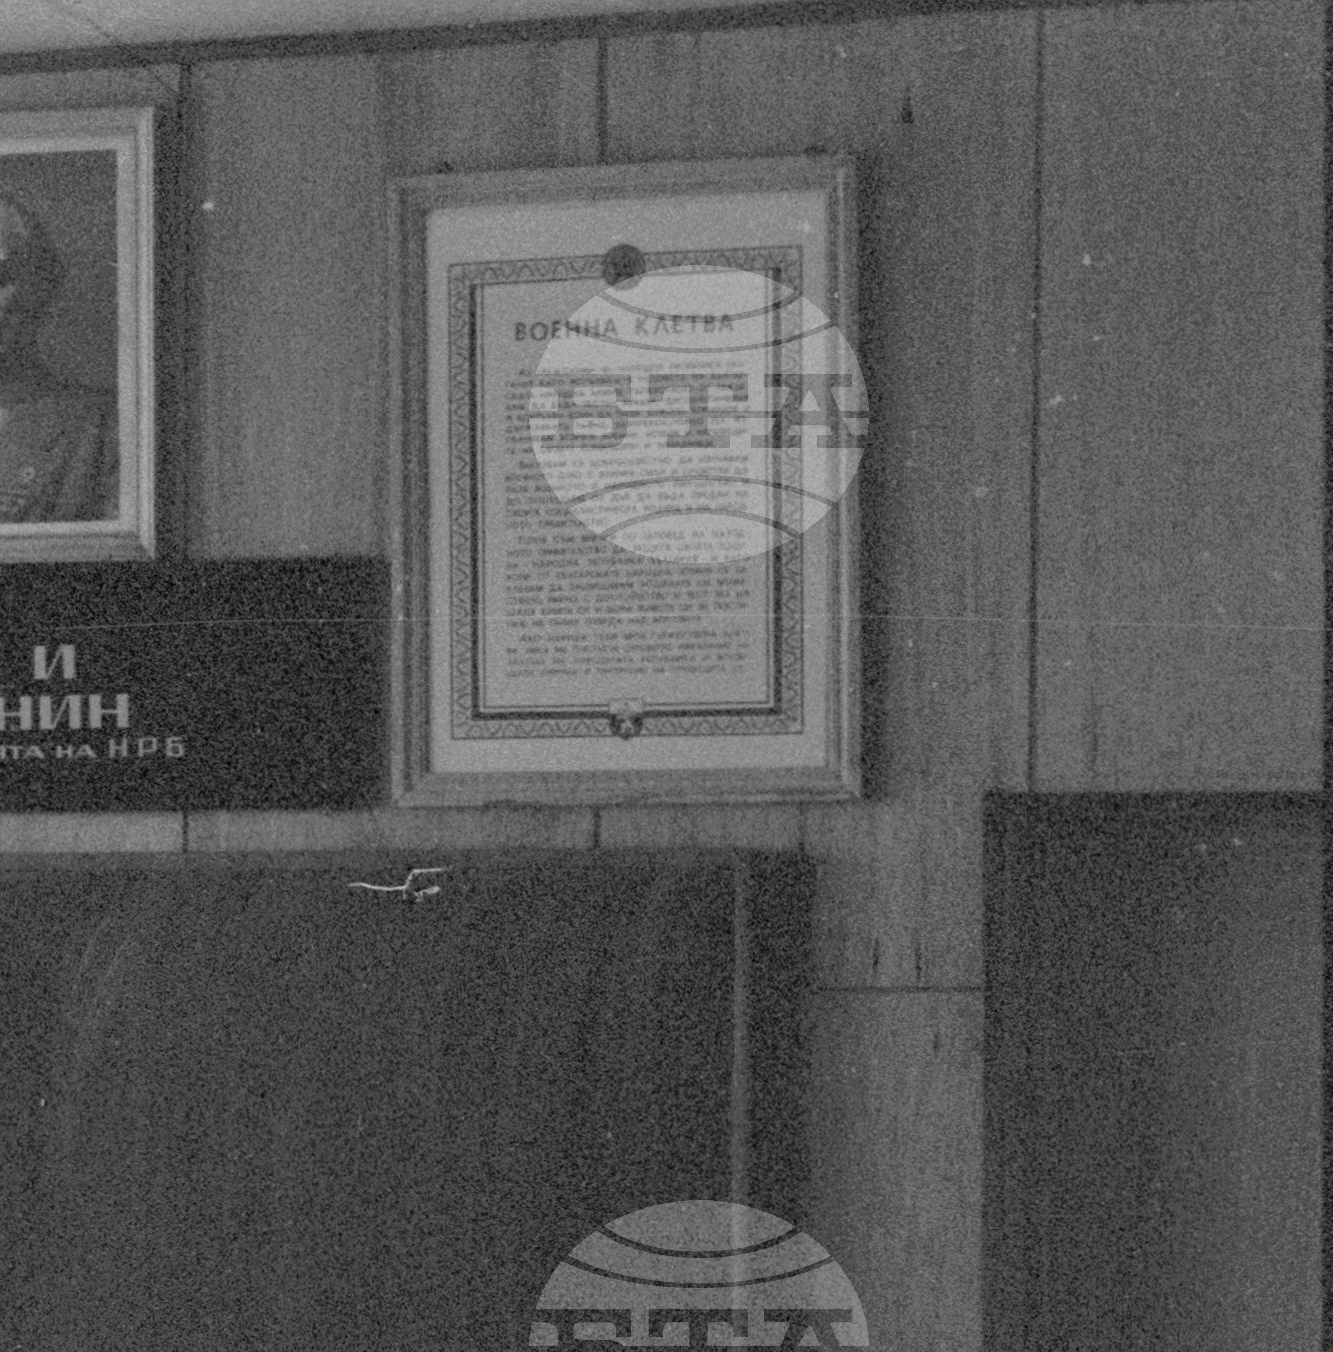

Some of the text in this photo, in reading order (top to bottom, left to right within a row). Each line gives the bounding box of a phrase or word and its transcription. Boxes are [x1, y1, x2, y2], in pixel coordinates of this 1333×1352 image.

[514, 313, 734, 342] ВОЕННА КЛЕТВА
[32, 643, 77, 681] И
